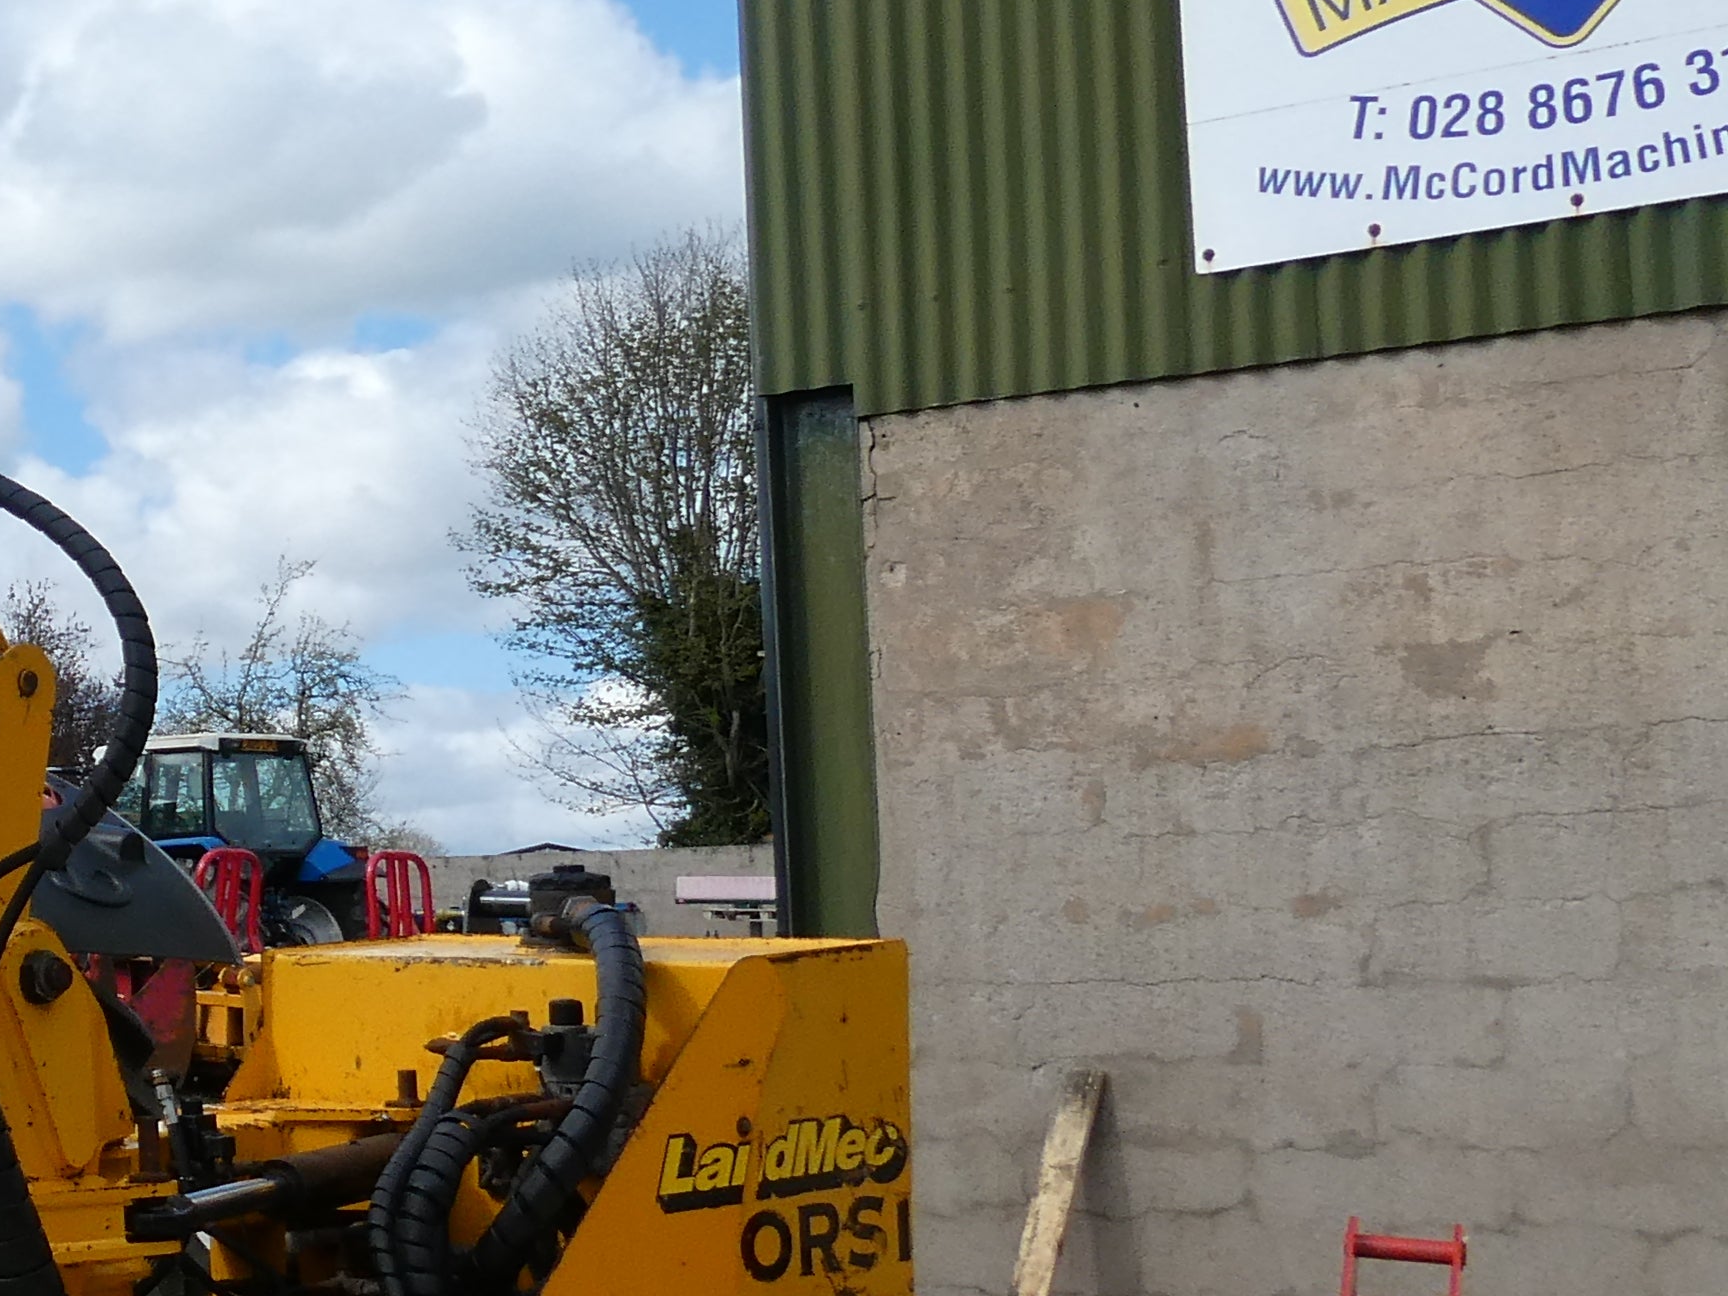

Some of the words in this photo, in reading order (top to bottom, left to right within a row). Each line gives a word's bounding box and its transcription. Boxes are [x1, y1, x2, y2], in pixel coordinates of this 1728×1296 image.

[1350, 95, 1388, 140] T:
[1408, 90, 1506, 140] 028
[1528, 62, 1666, 130] 8676
[1685, 47, 1728, 96] 3
[741, 1196, 913, 1283] ORSI
